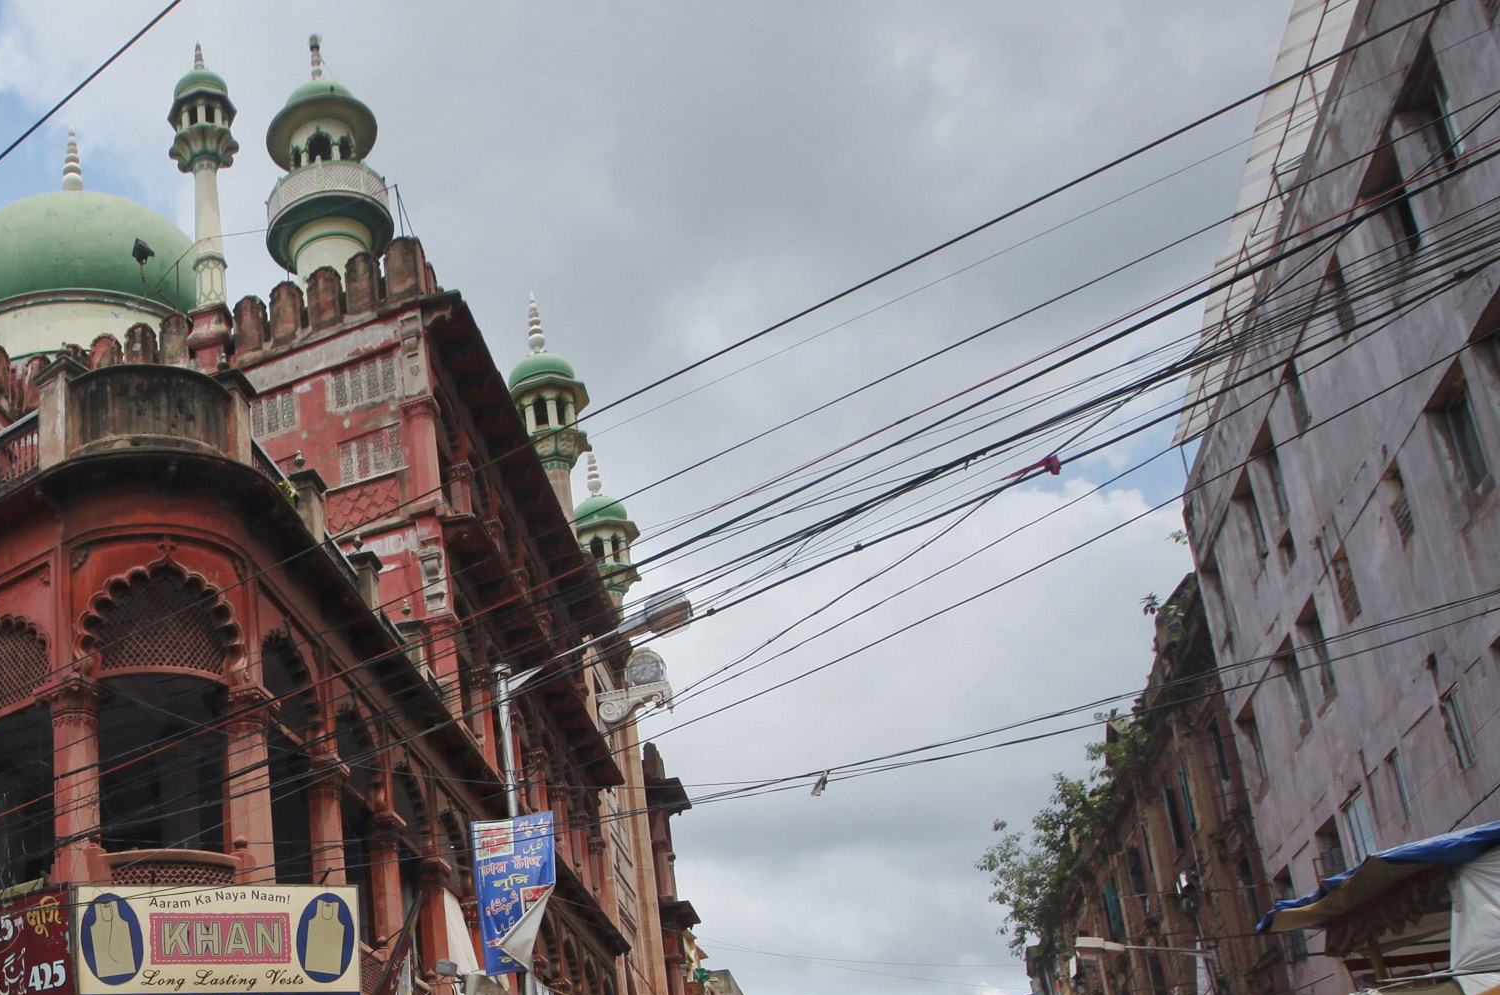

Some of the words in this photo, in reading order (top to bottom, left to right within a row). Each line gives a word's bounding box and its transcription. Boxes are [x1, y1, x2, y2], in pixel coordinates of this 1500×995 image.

[480, 861, 508, 877] চার
[149, 896, 191, 909] Aaram
[195, 894, 211, 906] Ka
[215, 890, 246, 904] Naya
[251, 890, 291, 904] Naam!
[161, 920, 284, 956] KHAN
[28, 960, 66, 991] 425
[141, 970, 186, 991] Long
[193, 970, 258, 991] Lasting
[266, 969, 305, 985] Vests
